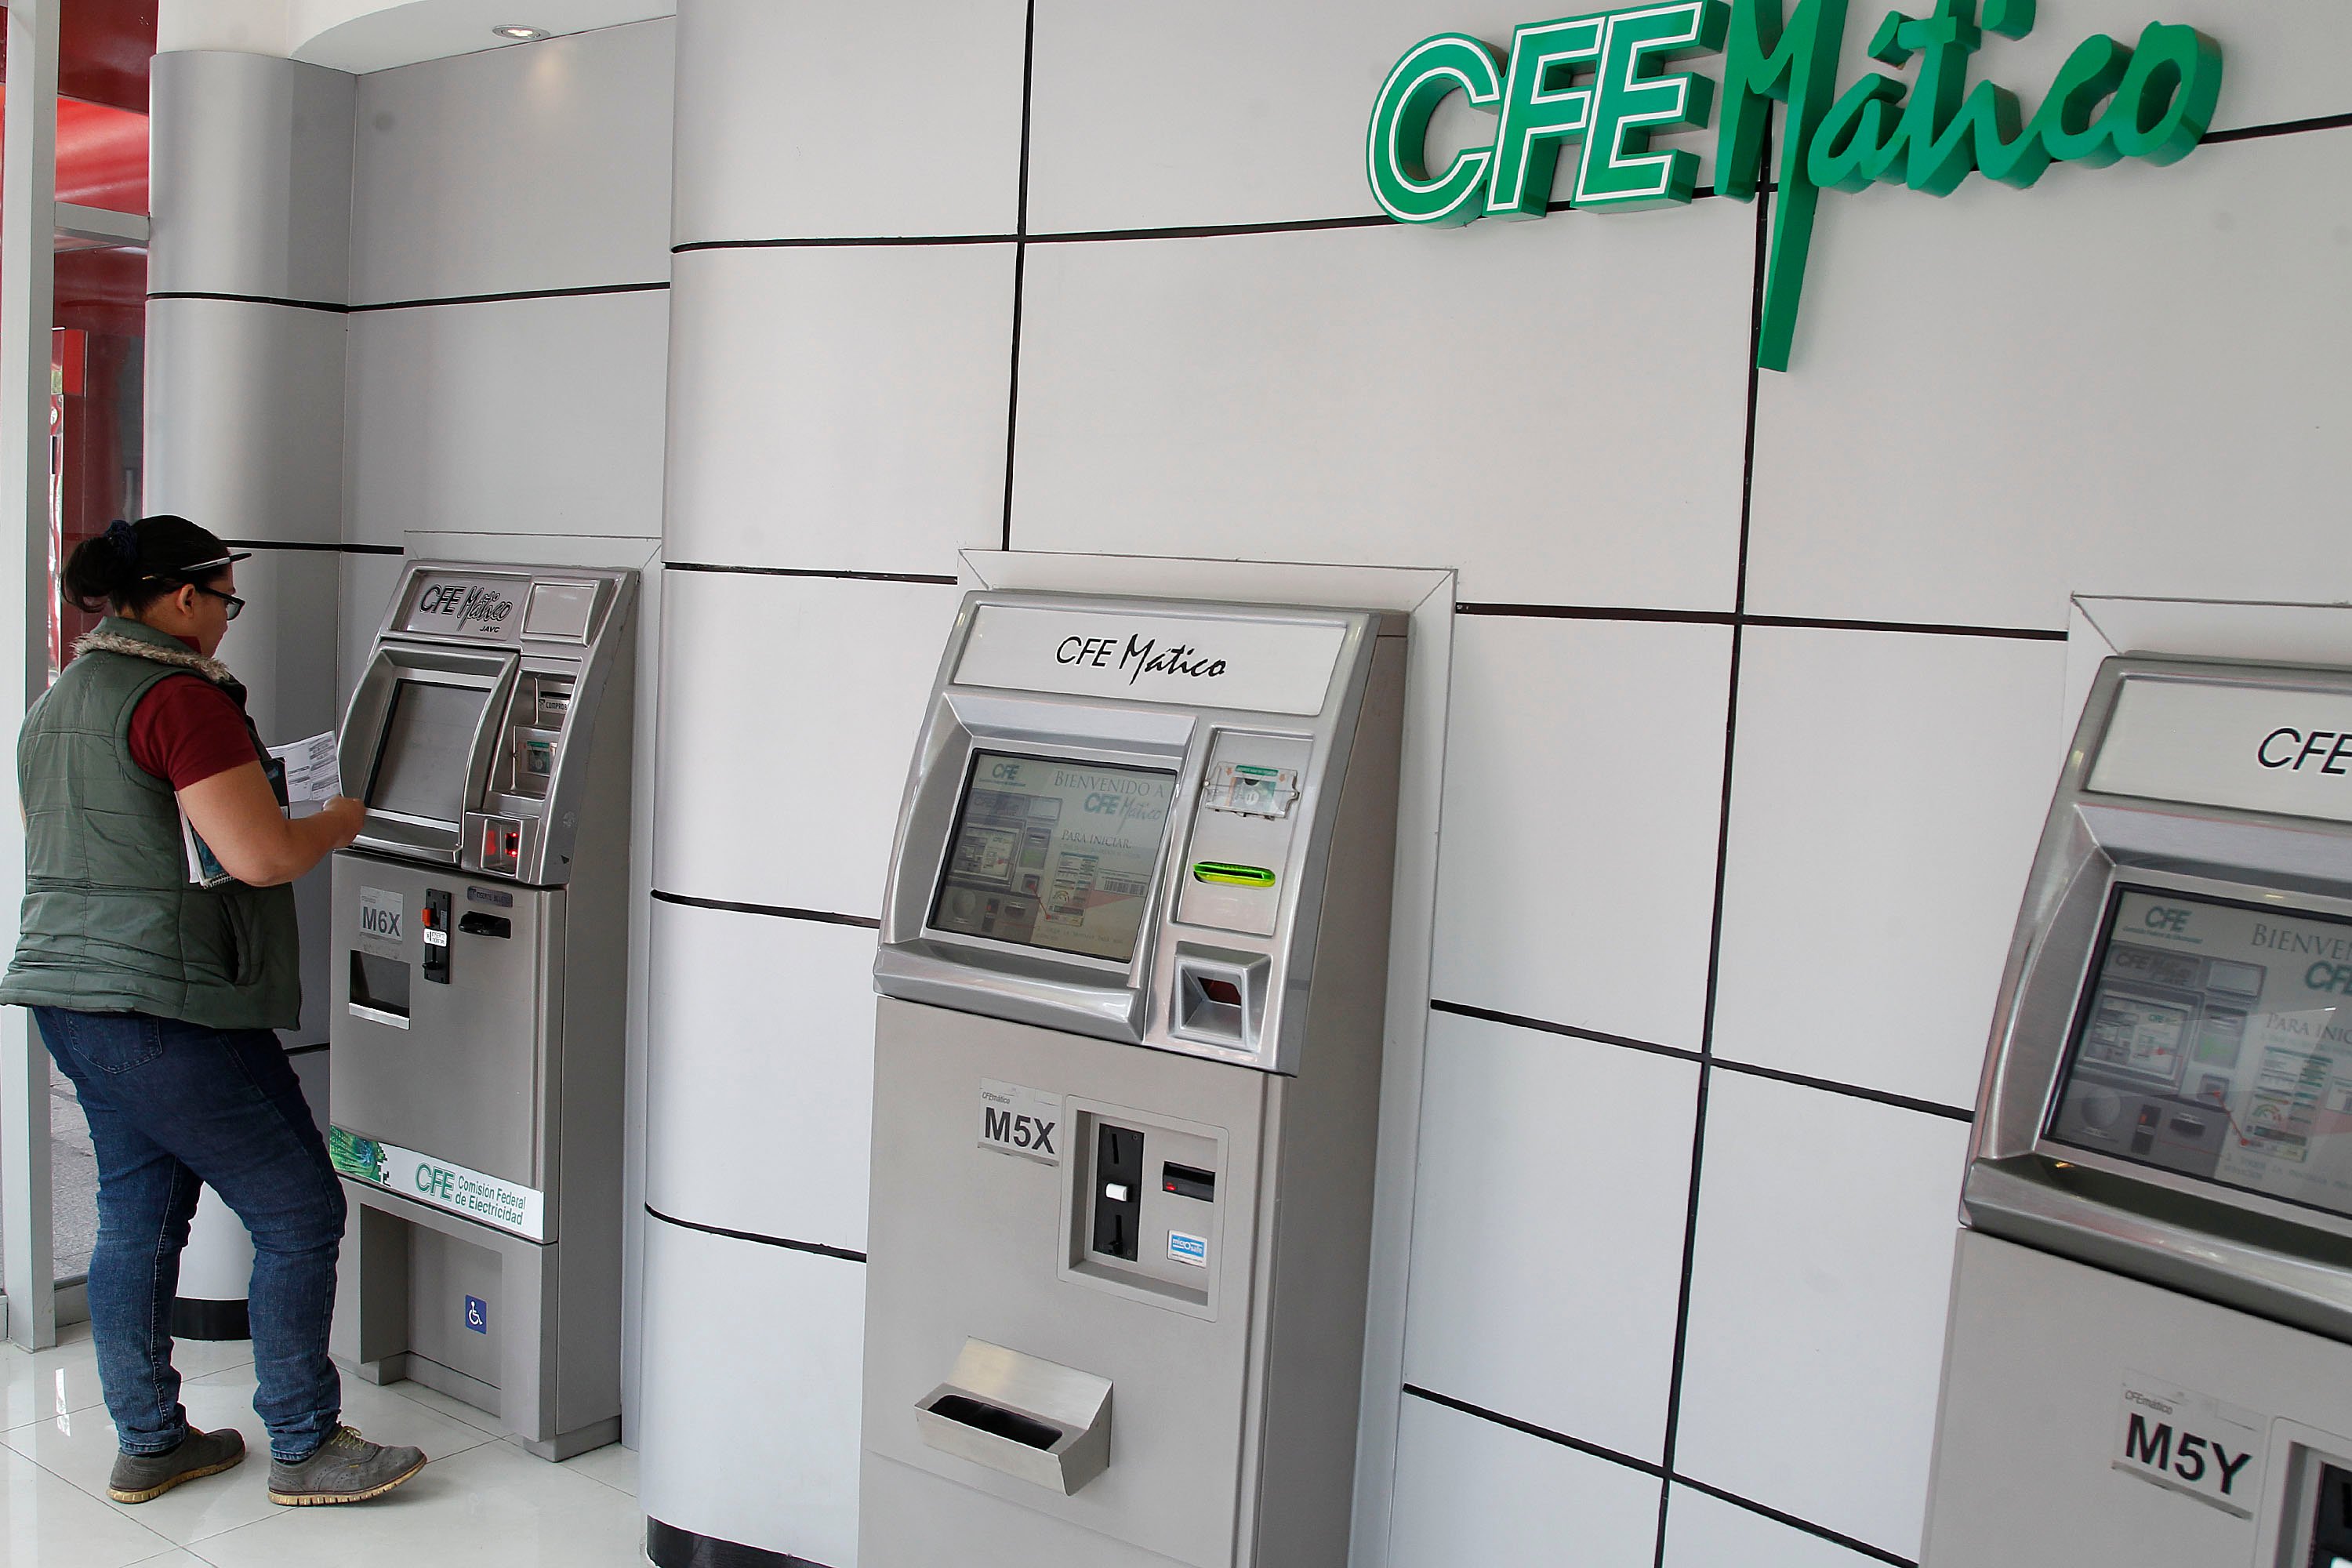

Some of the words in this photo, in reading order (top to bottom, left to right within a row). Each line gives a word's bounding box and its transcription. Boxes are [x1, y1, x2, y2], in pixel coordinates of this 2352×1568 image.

[1366, 0, 1726, 229] CFE
[420, 584, 466, 615] CFE
[1056, 636, 1118, 667] CFE
[2258, 728, 2352, 775] CFE
[1054, 771, 1151, 797] BIENVENIDO
[1153, 785, 1164, 798] A
[1083, 792, 1122, 815] CFE
[1061, 829, 1087, 843] PARA
[362, 906, 401, 937] M6X
[2145, 906, 2193, 932] CFE
[985, 1106, 1055, 1155] M5X
[415, 1162, 456, 1202] CFE
[458, 1174, 495, 1198] Comisión
[495, 1187, 527, 1210] Federal
[455, 1191, 466, 1206] de
[469, 1195, 523, 1225] Electricidad
[2125, 1412, 2252, 1495] M5Y
